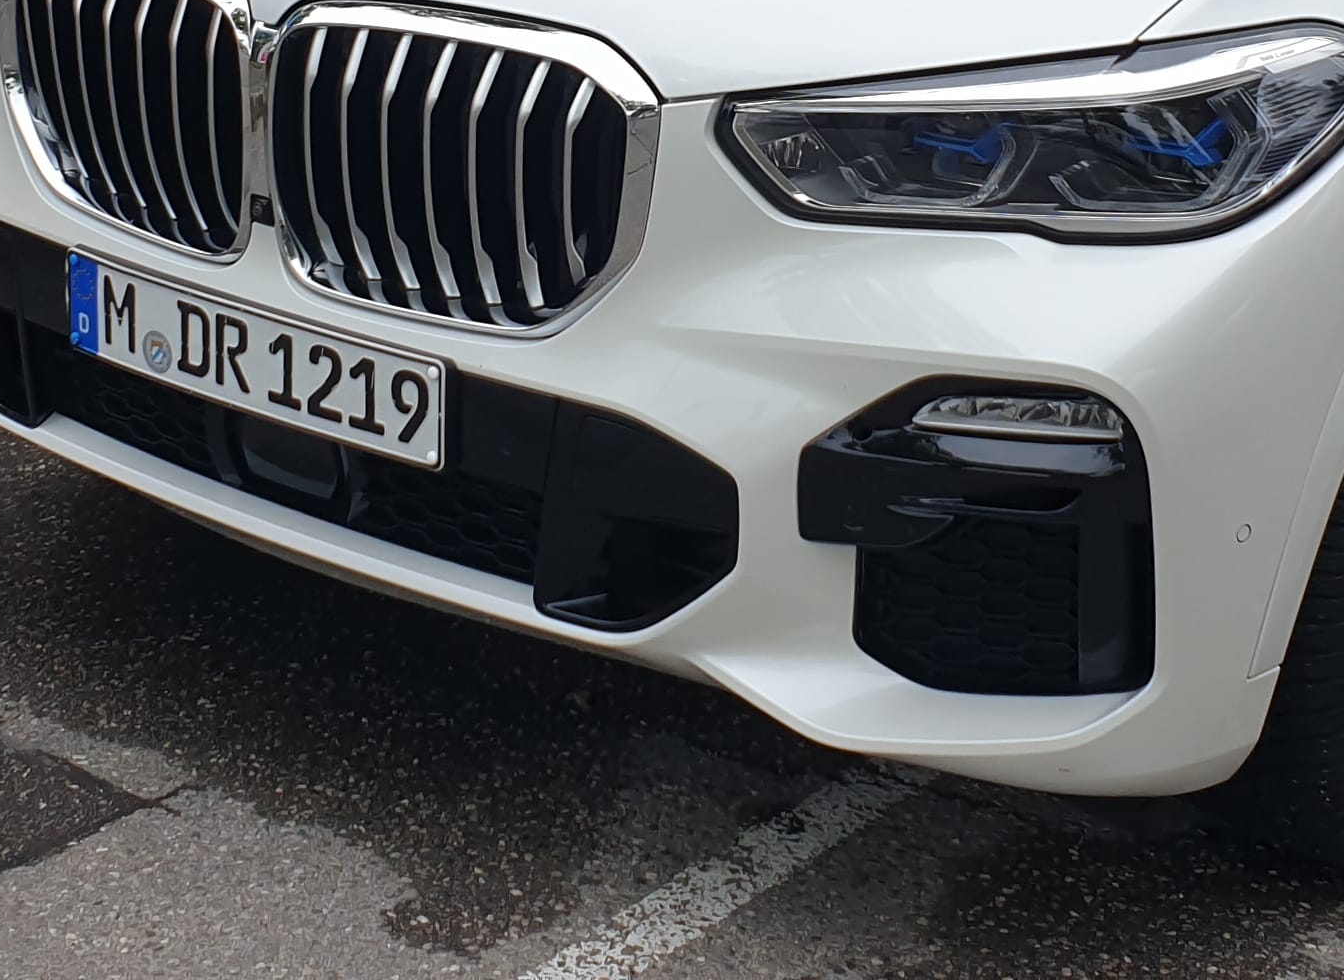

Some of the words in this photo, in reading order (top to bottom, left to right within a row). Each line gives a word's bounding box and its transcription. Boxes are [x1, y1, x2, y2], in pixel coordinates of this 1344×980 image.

[79, 312, 90, 334] D
[103, 274, 136, 353] M
[177, 299, 250, 394] DR
[268, 333, 430, 443] 1219
